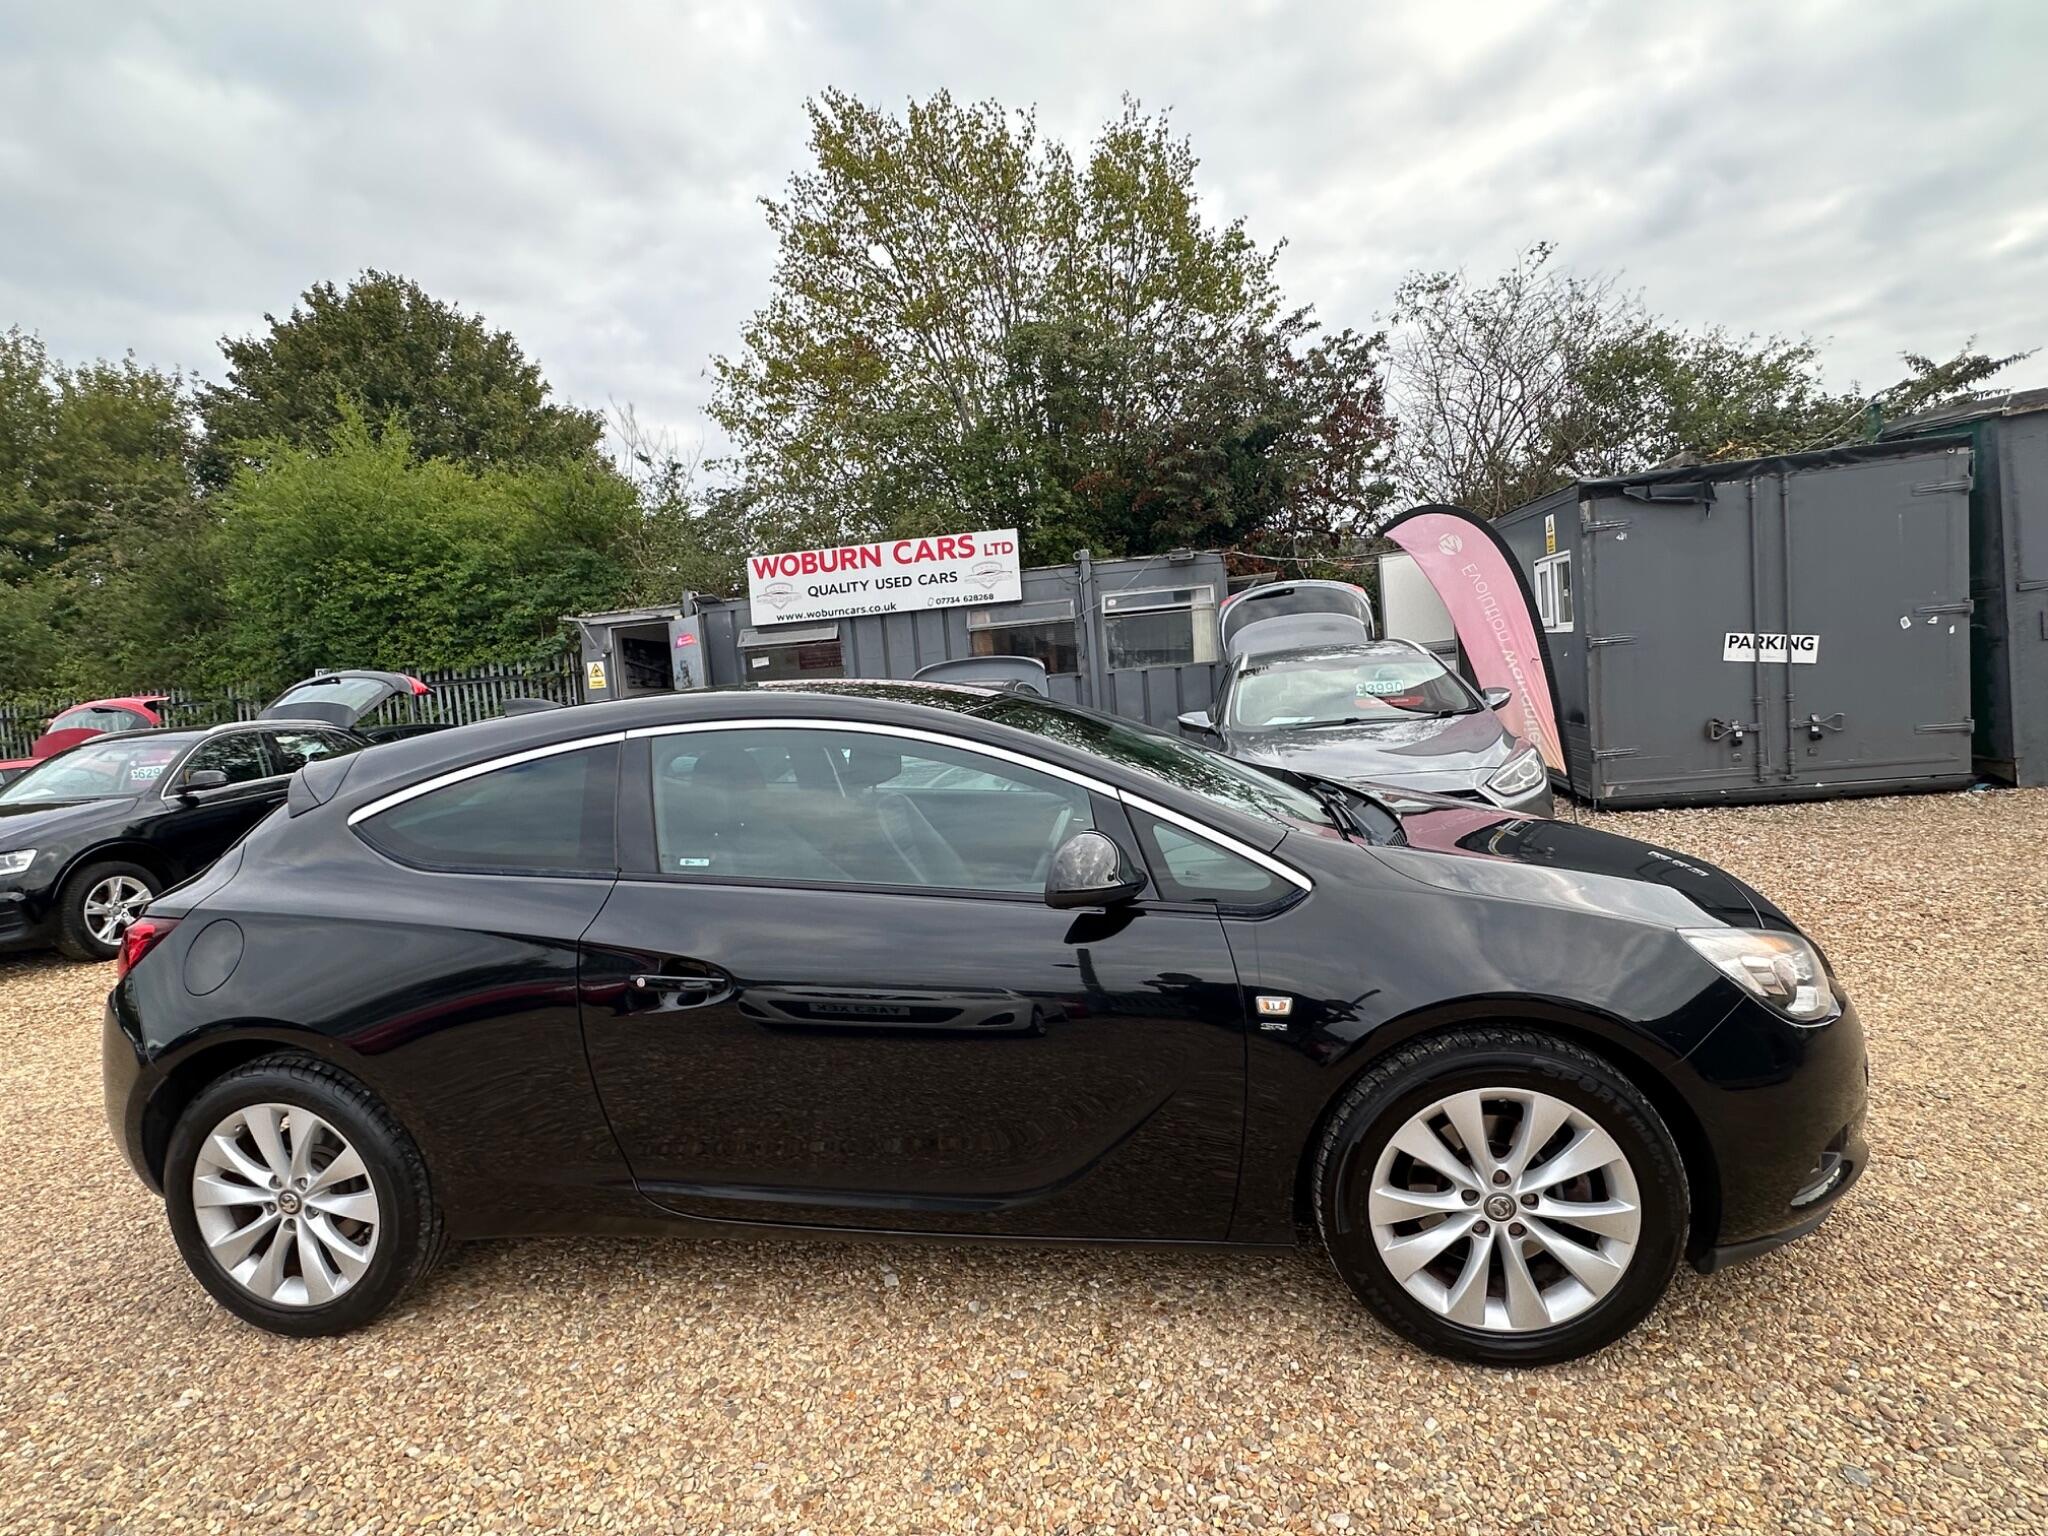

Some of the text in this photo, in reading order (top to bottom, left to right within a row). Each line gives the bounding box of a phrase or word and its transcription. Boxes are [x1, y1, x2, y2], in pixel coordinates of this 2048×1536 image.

[752, 535, 1013, 579] WOBURN CARS LTD
[808, 580, 869, 597] QUALITY
[875, 576, 912, 590] USED
[918, 571, 958, 585] CARS
[776, 602, 896, 621] www.woburncars.co.uk
[1728, 635, 1814, 651] PARKING
